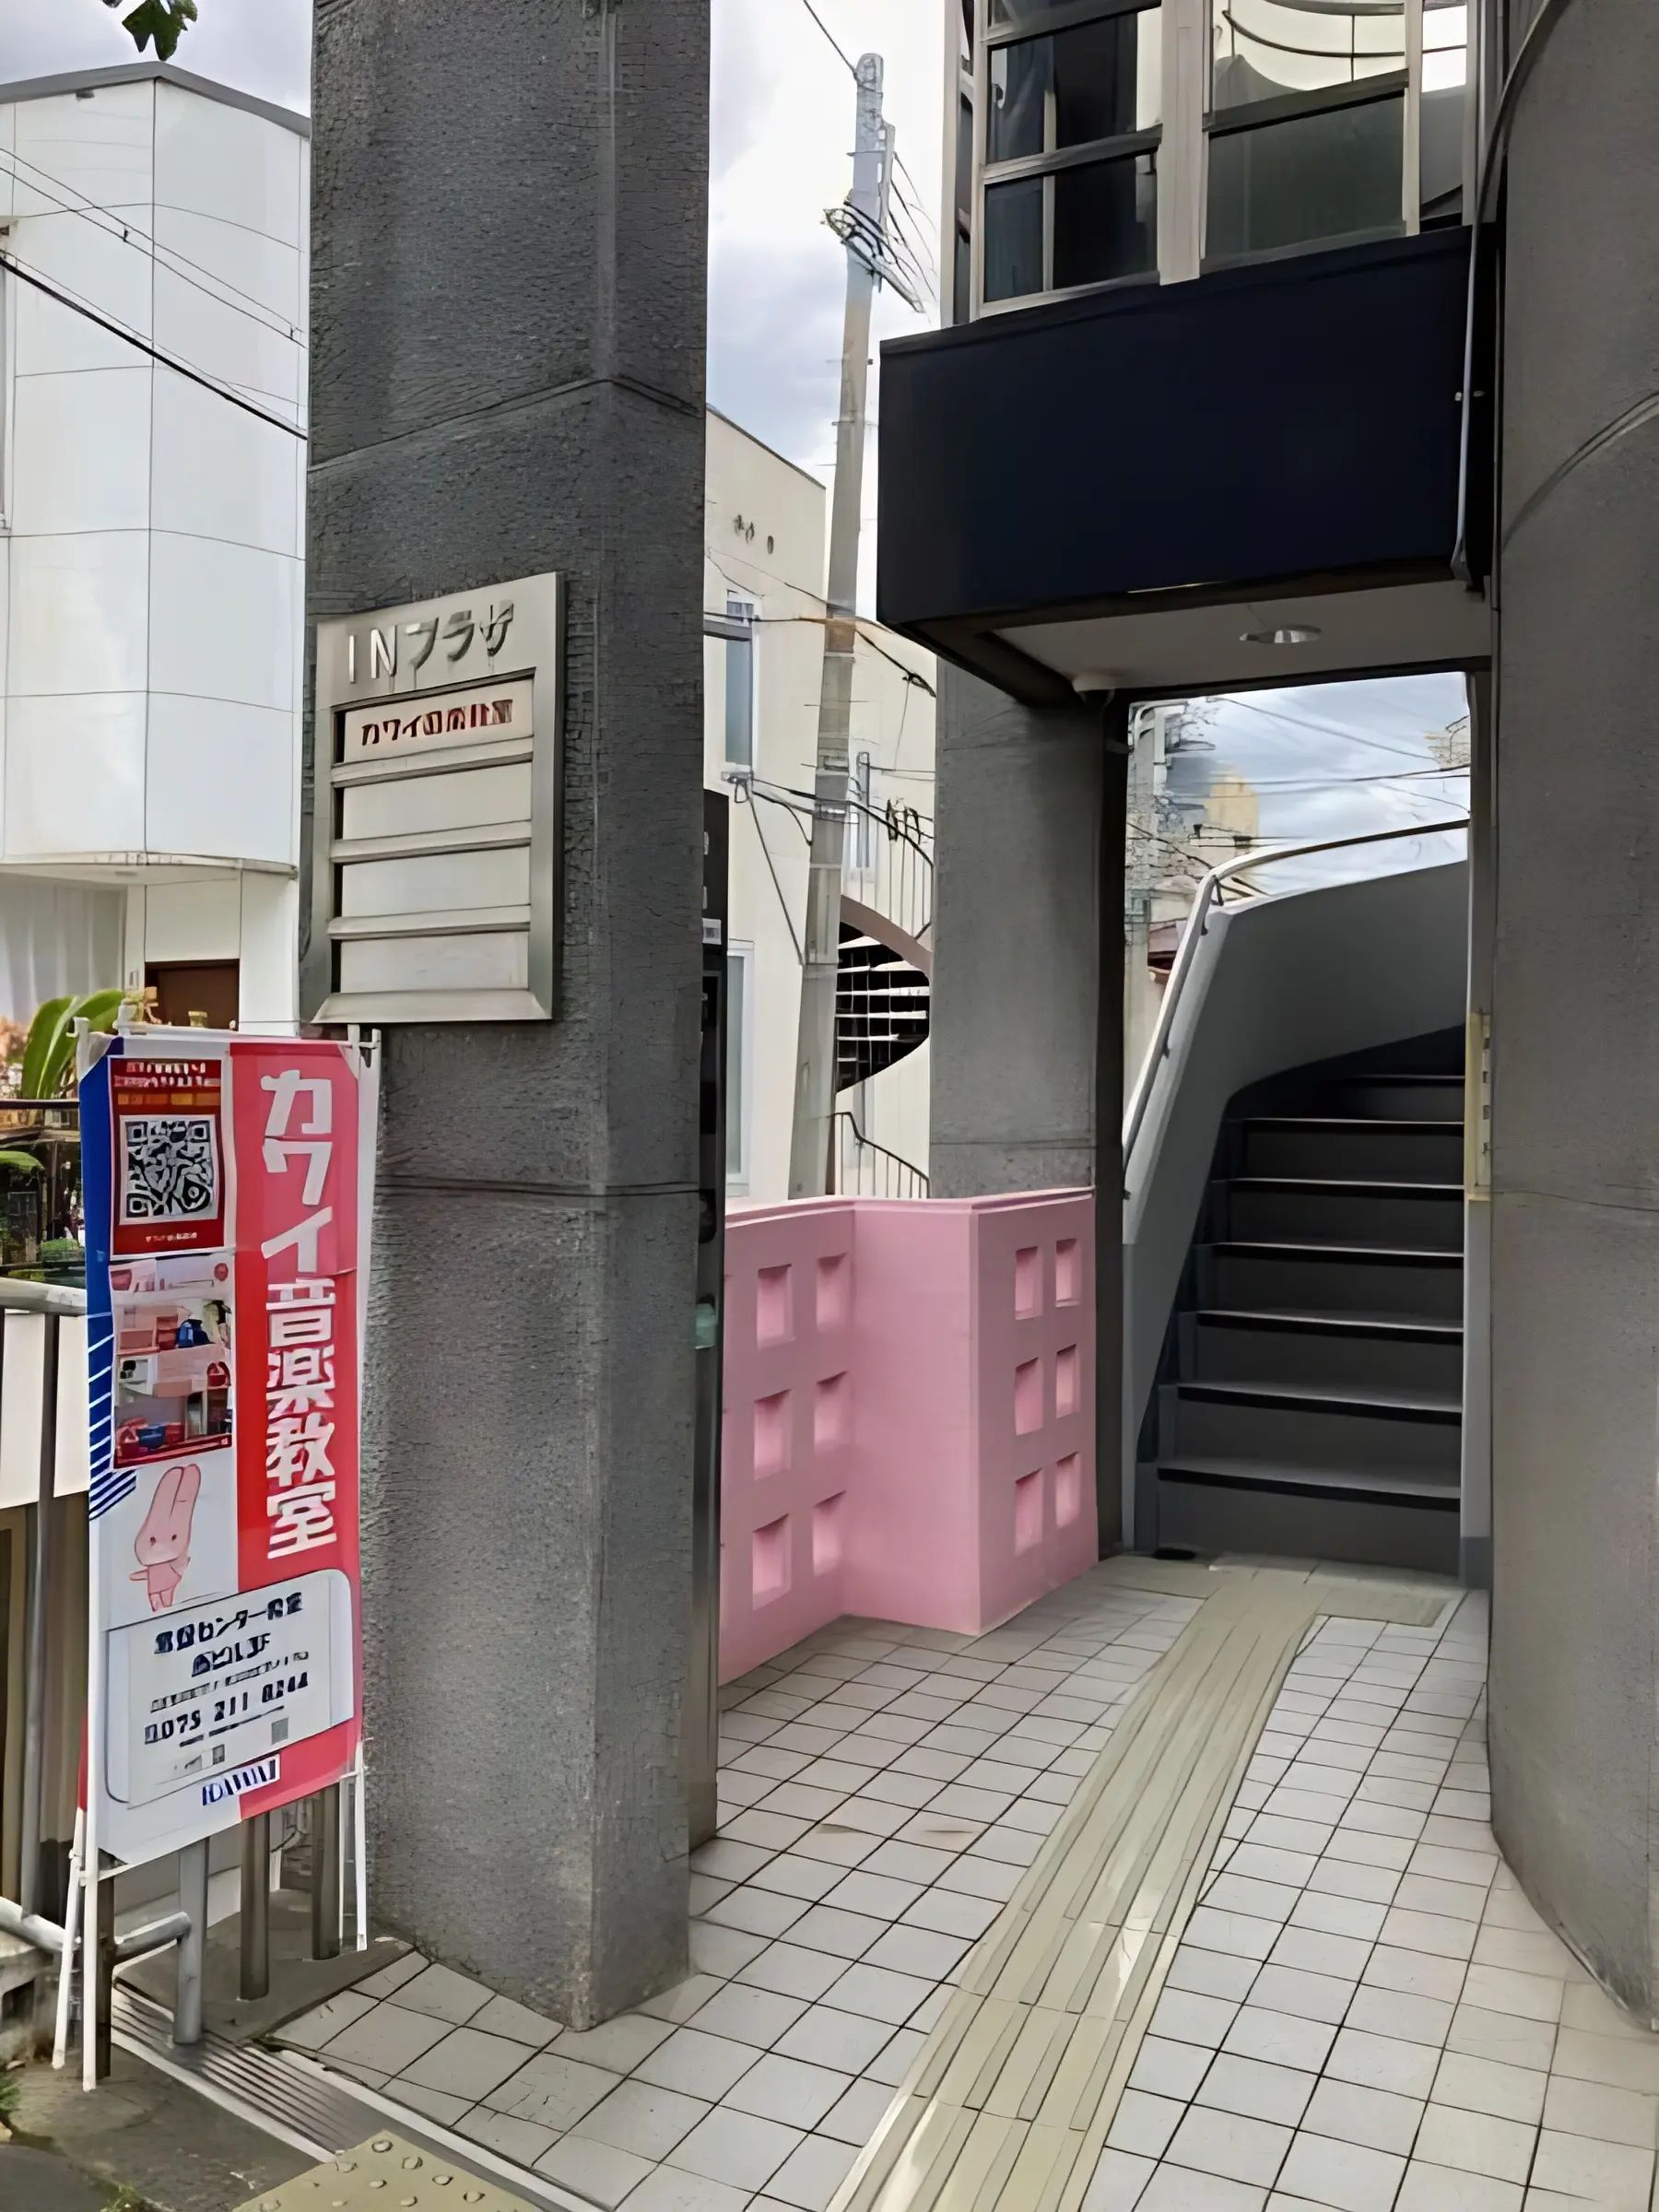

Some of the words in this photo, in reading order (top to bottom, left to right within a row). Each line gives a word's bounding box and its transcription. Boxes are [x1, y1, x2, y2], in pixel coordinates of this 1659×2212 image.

[261, 1069, 337, 1559] カワイ音楽教室
